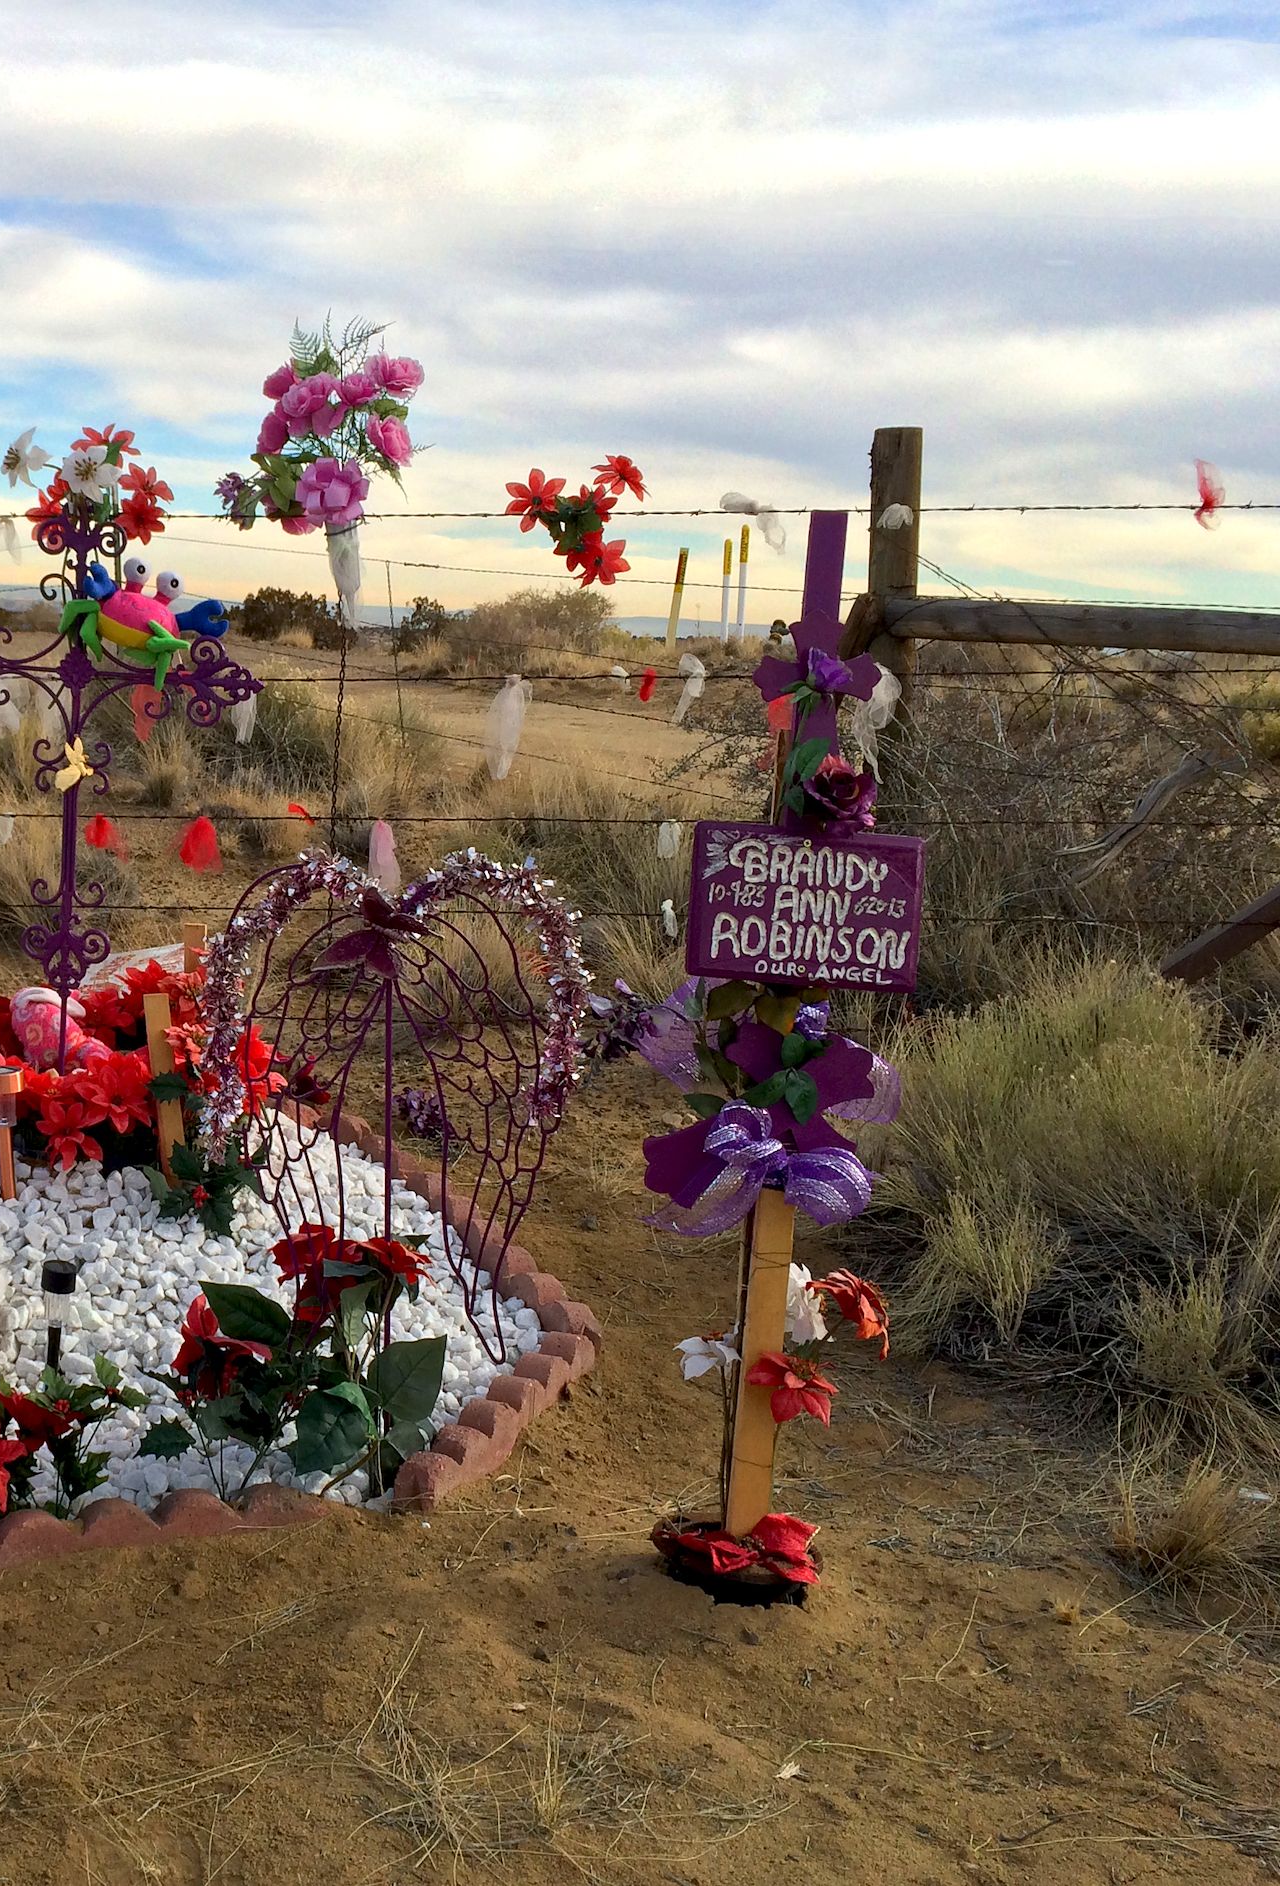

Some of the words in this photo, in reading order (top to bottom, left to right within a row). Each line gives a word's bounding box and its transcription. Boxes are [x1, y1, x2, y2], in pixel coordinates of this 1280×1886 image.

[729, 838, 889, 893] BRANDY
[771, 885, 853, 926] ANN
[710, 912, 911, 970] ROBINSON
[755, 959, 801, 977] OUR
[809, 963, 893, 985] ANGEL
